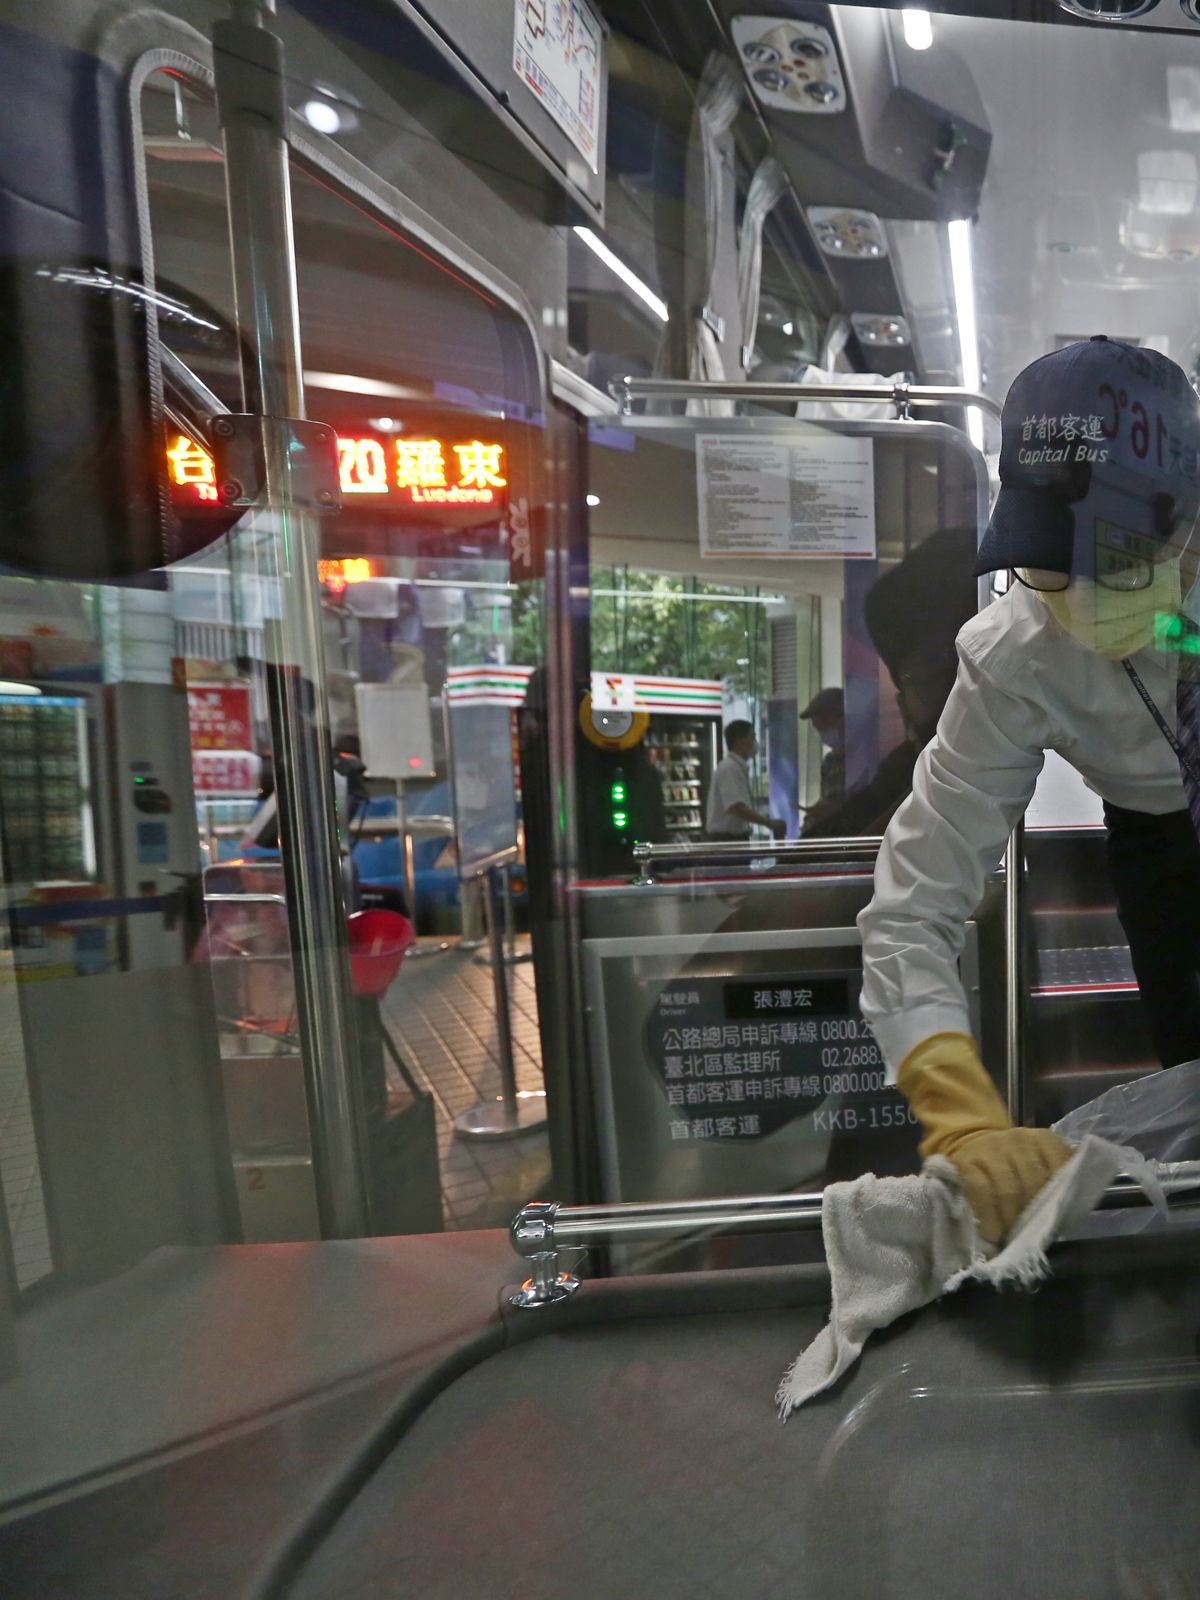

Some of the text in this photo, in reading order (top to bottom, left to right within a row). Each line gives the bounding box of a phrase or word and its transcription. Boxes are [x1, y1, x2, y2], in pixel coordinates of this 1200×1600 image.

[1020, 413, 1107, 442] 首都客運
[167, 436, 216, 485] 台
[395, 439, 508, 488] 羅東
[1018, 446, 1109, 465] Capital Bus
[661, 1022, 818, 1050] 公路總局申訴專線
[664, 1046, 887, 1079] 臺北區監理所 02.2688.
[665, 1075, 821, 1105] 首都客運申訴專線
[668, 1114, 761, 1140] 首都客運
